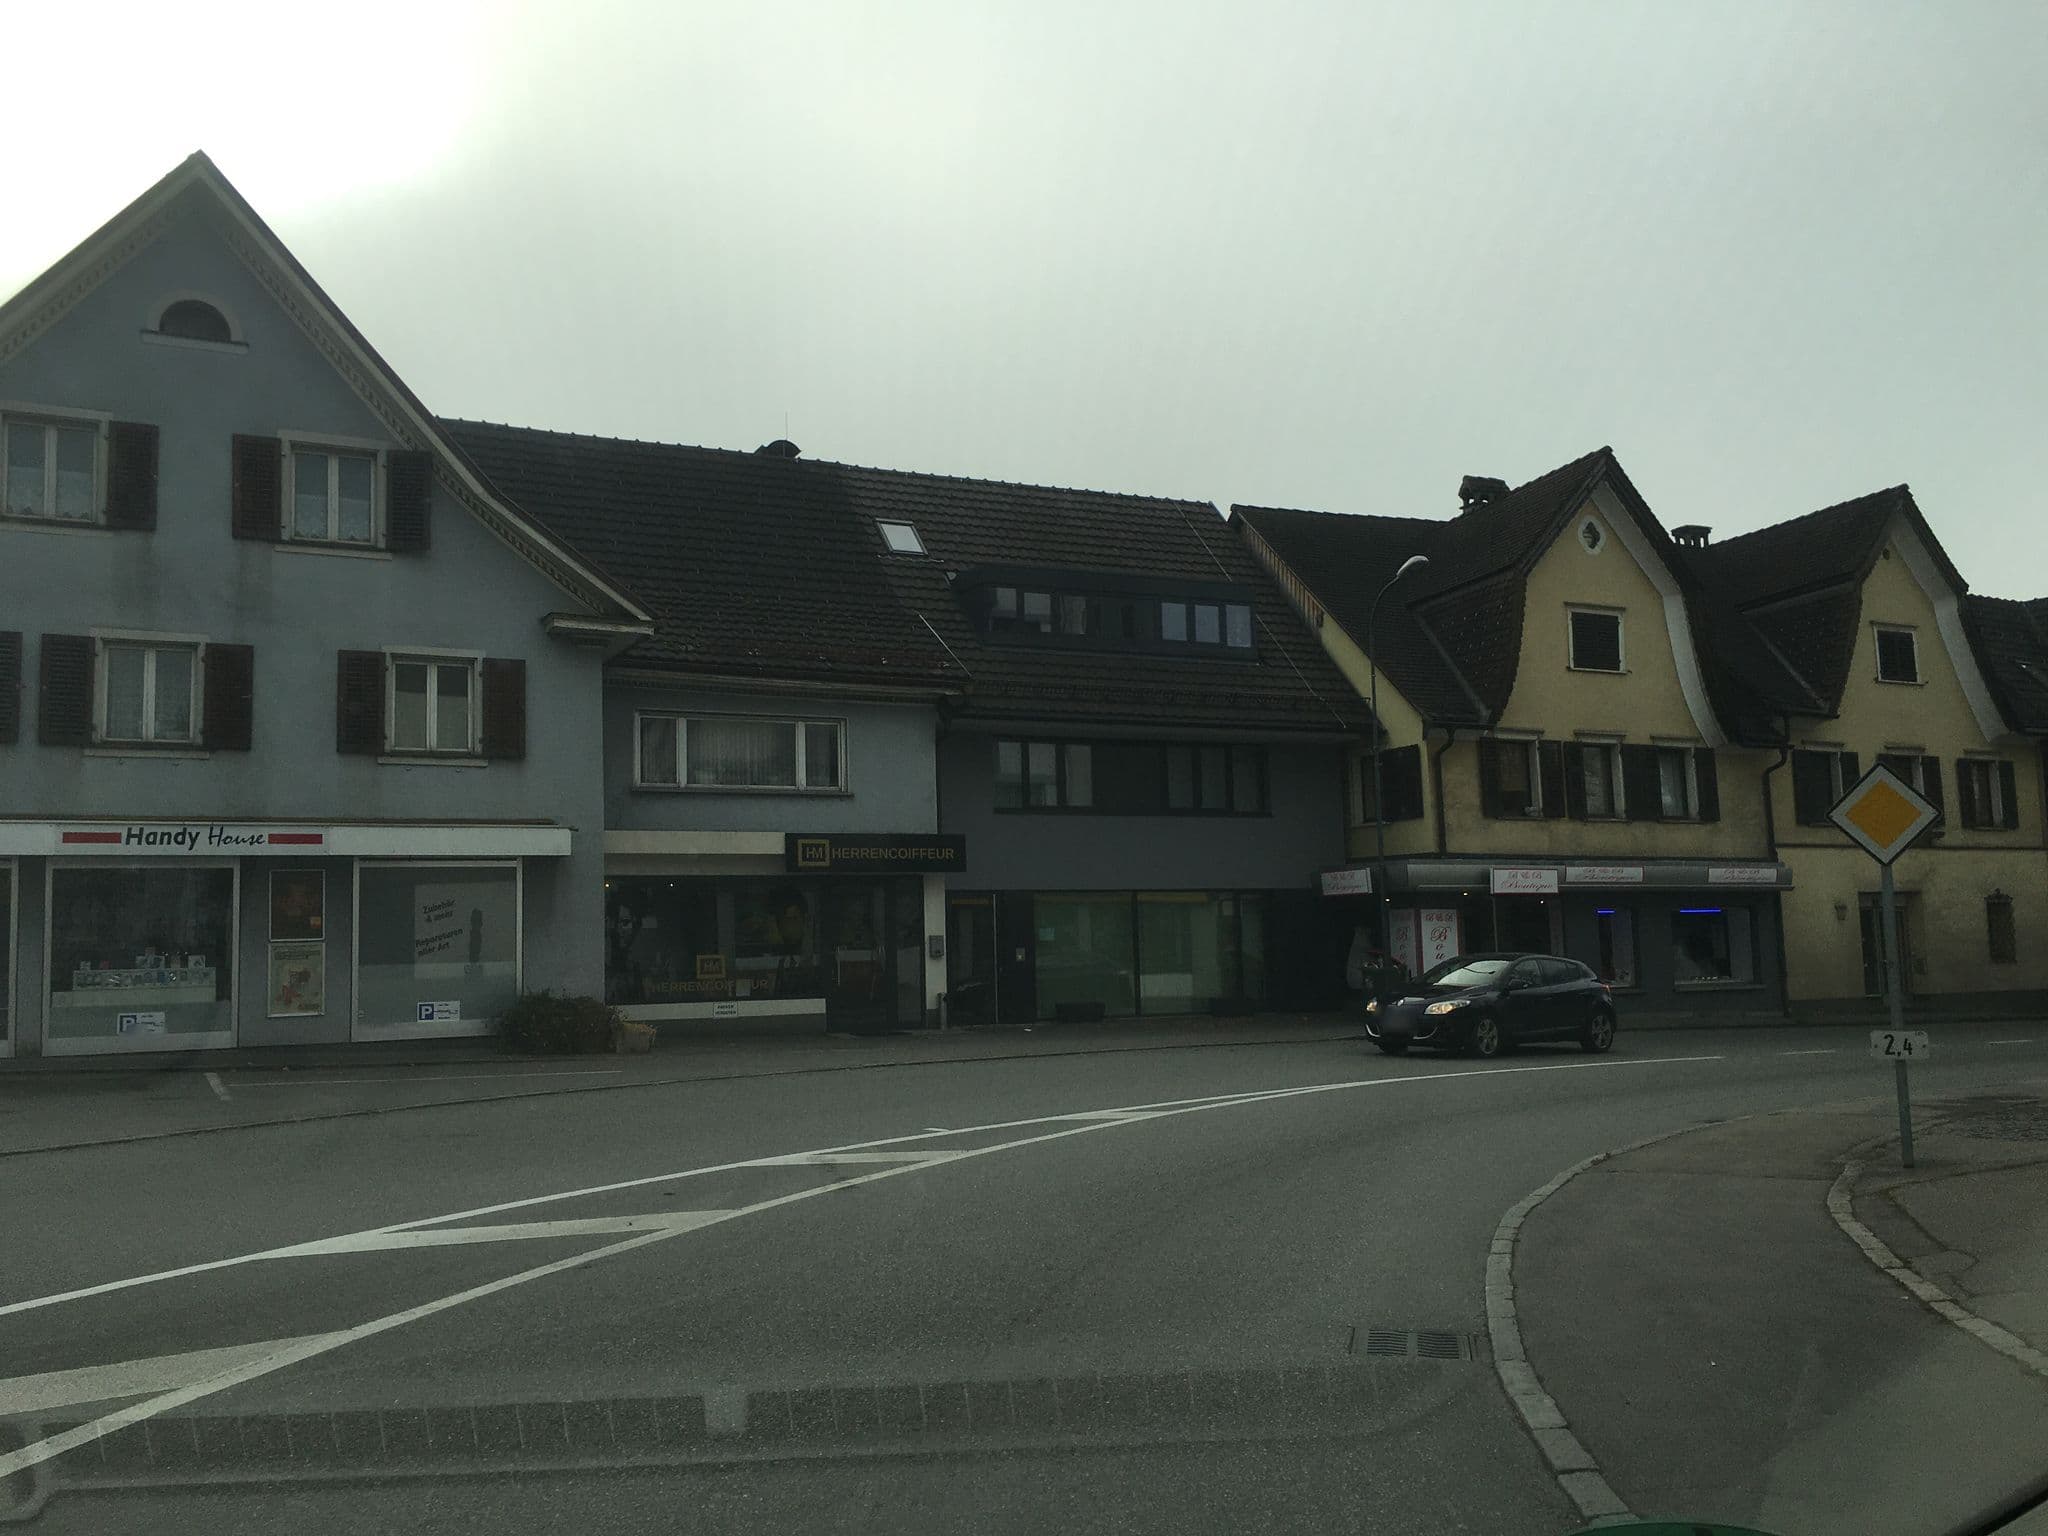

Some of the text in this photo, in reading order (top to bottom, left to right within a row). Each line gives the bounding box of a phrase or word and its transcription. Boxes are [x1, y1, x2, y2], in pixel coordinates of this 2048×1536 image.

[125, 826, 266, 850] Handy House
[832, 847, 955, 860] HERRENCOIFFEUR
[1883, 1034, 1913, 1057] 2,4
